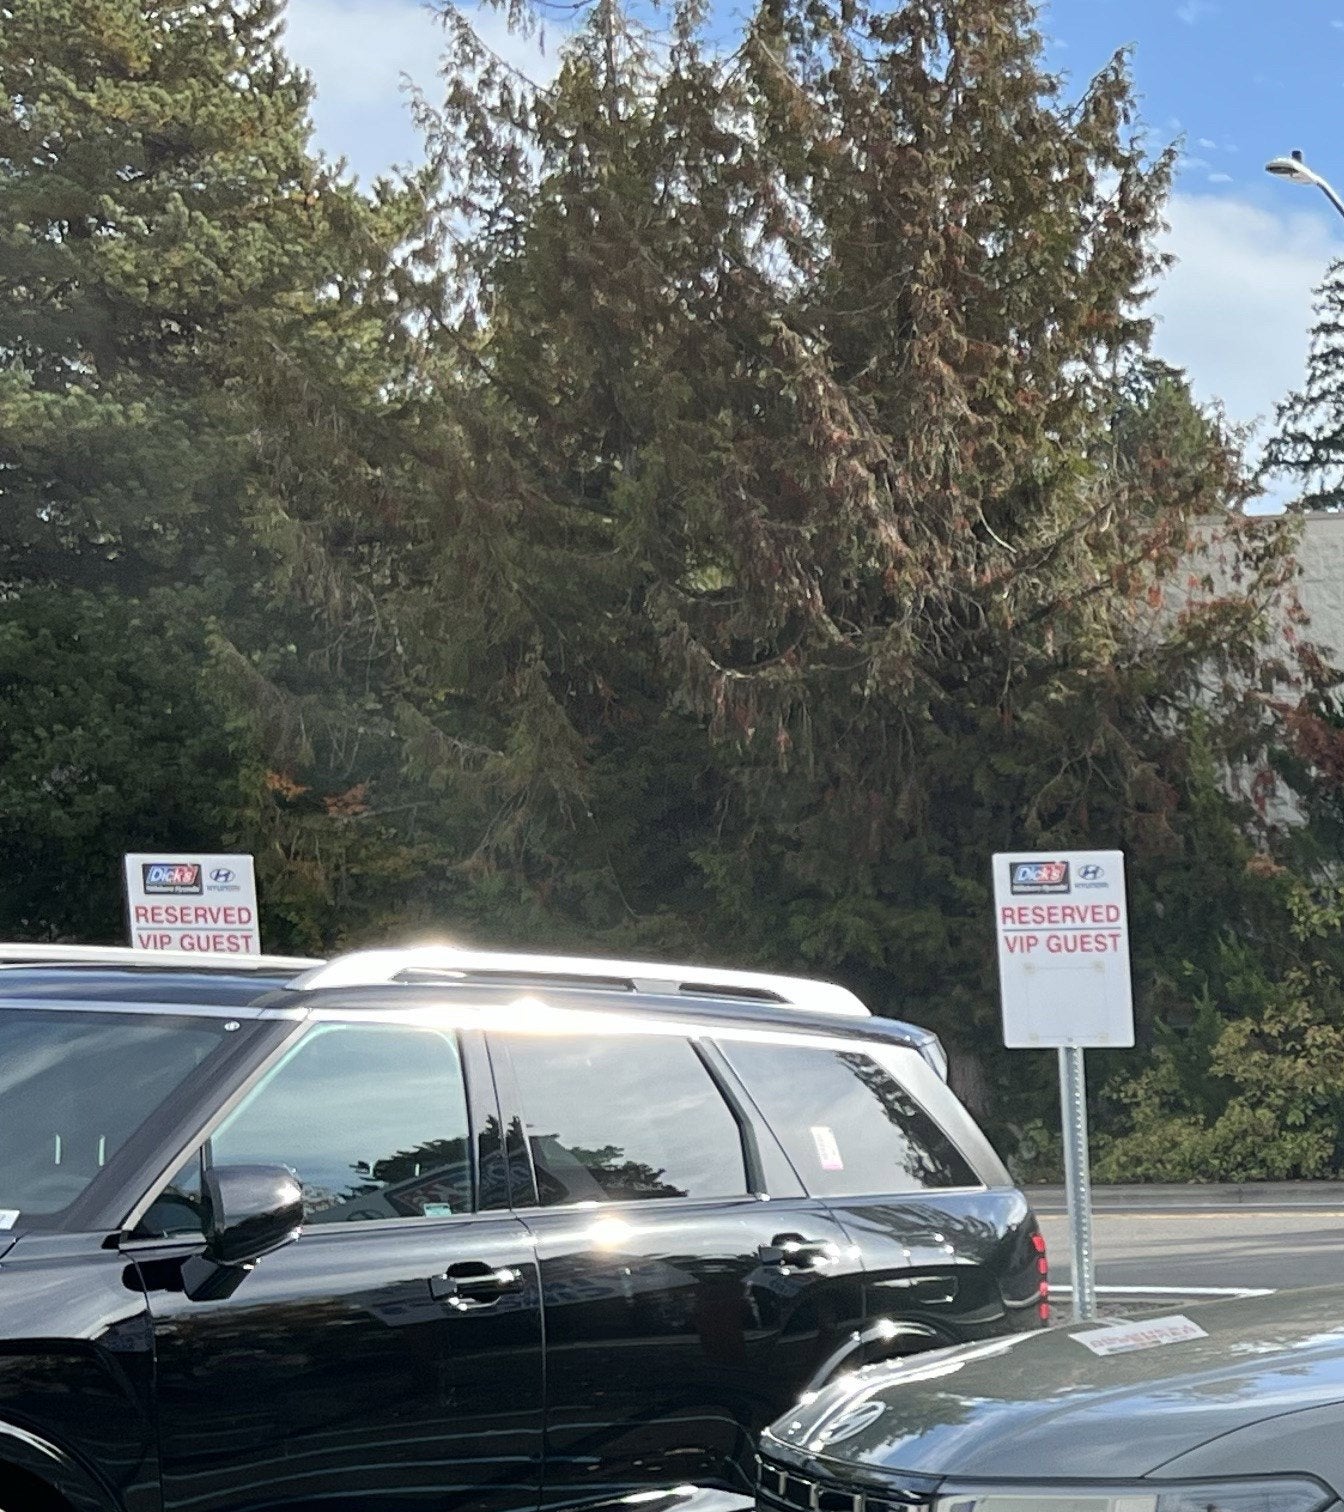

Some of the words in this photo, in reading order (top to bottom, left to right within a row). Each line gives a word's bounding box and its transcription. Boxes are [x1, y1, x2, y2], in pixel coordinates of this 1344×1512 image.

[134, 906, 252, 925] RESERVED
[1002, 904, 1121, 924] RESERVED
[138, 933, 173, 950] VIP
[180, 933, 253, 953] GUEST
[1004, 935, 1039, 953] VIP
[1046, 933, 1121, 953] GUEST
